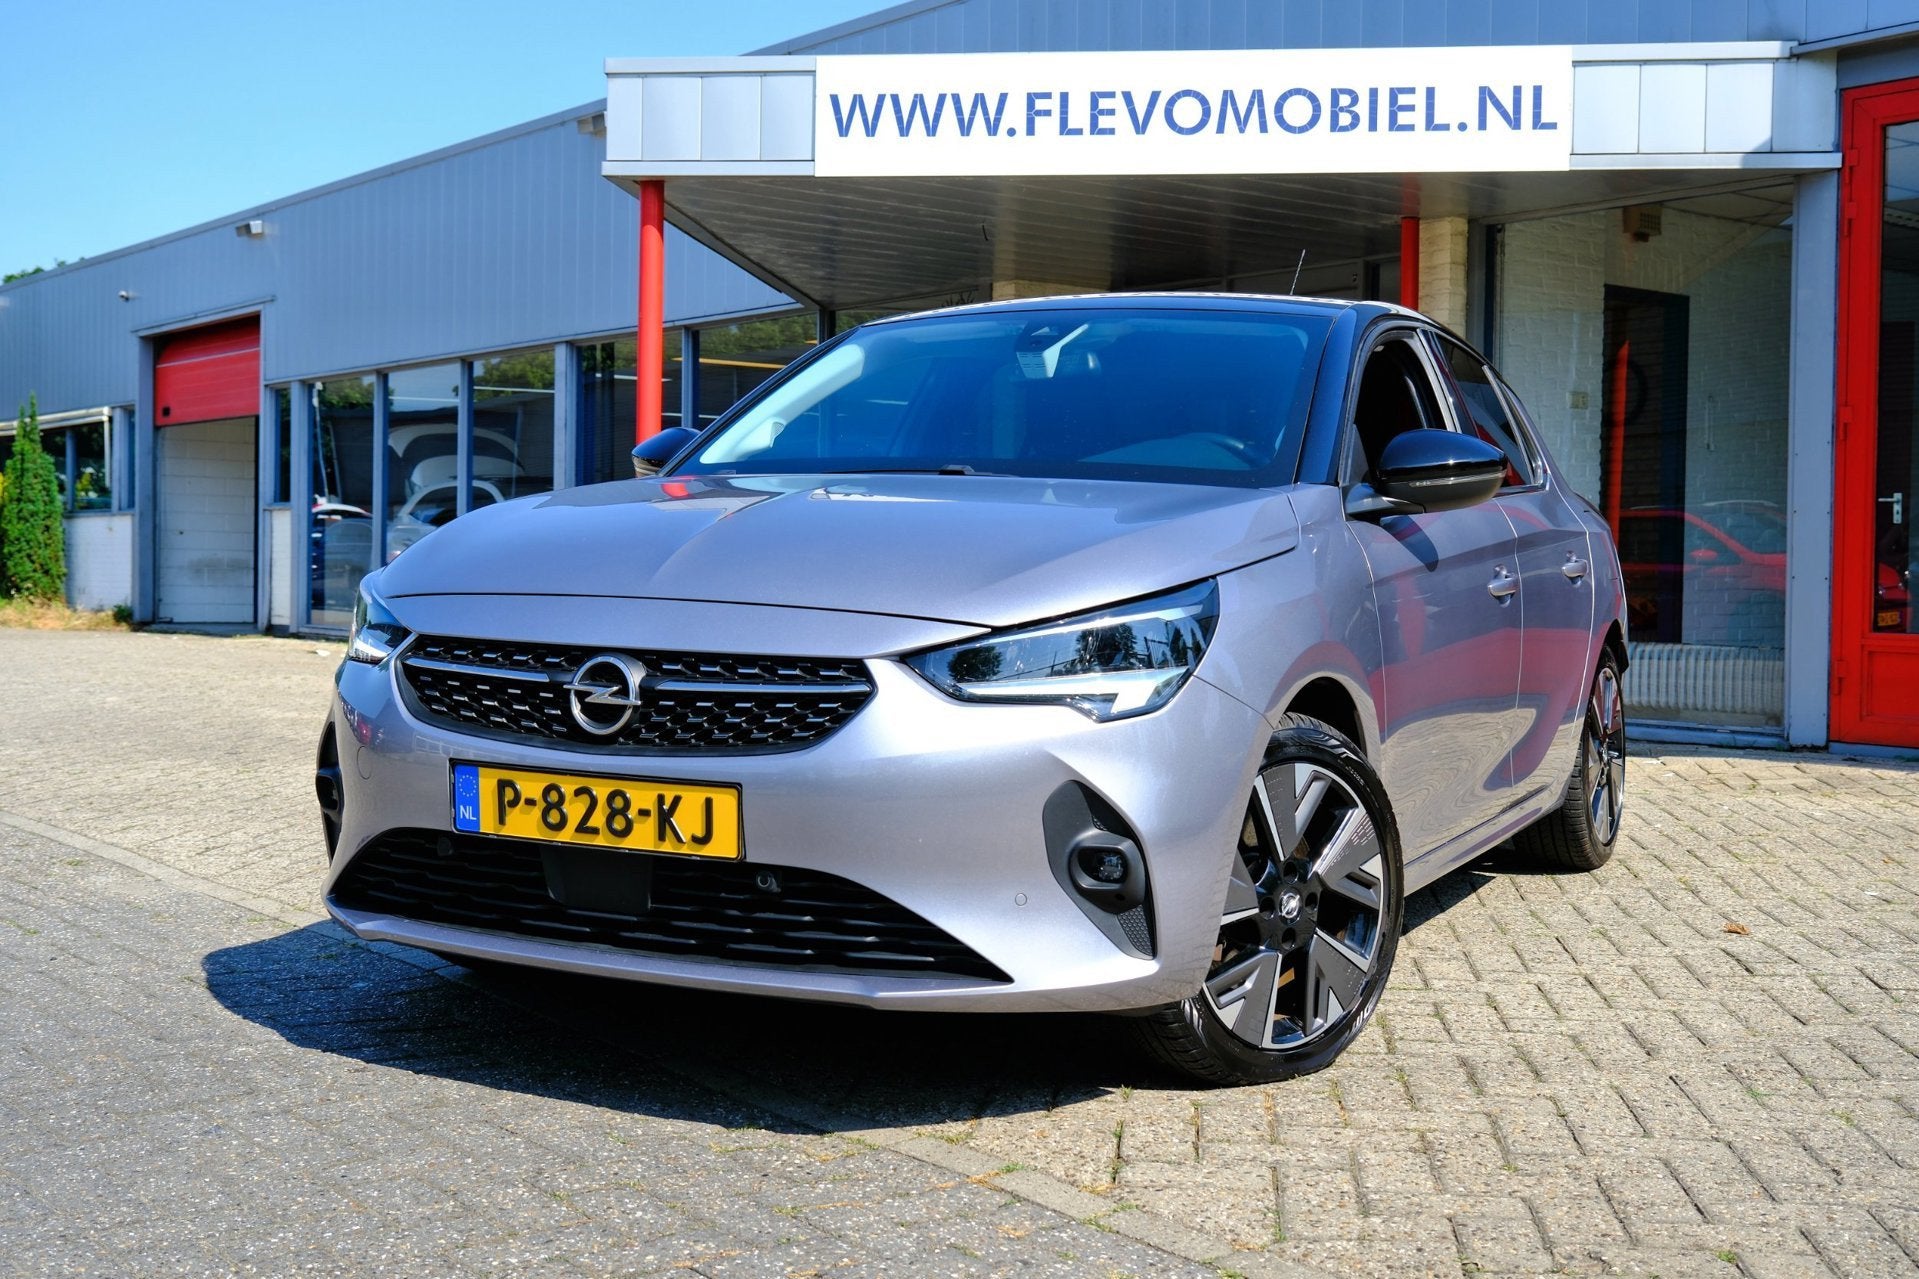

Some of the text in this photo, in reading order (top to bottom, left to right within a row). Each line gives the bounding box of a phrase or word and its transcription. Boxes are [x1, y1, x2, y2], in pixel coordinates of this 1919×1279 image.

[830, 85, 1558, 138] WWW.FLEVOMOBIEL.NL
[459, 804, 477, 821] NL
[496, 778, 714, 846] P-828-KJ
